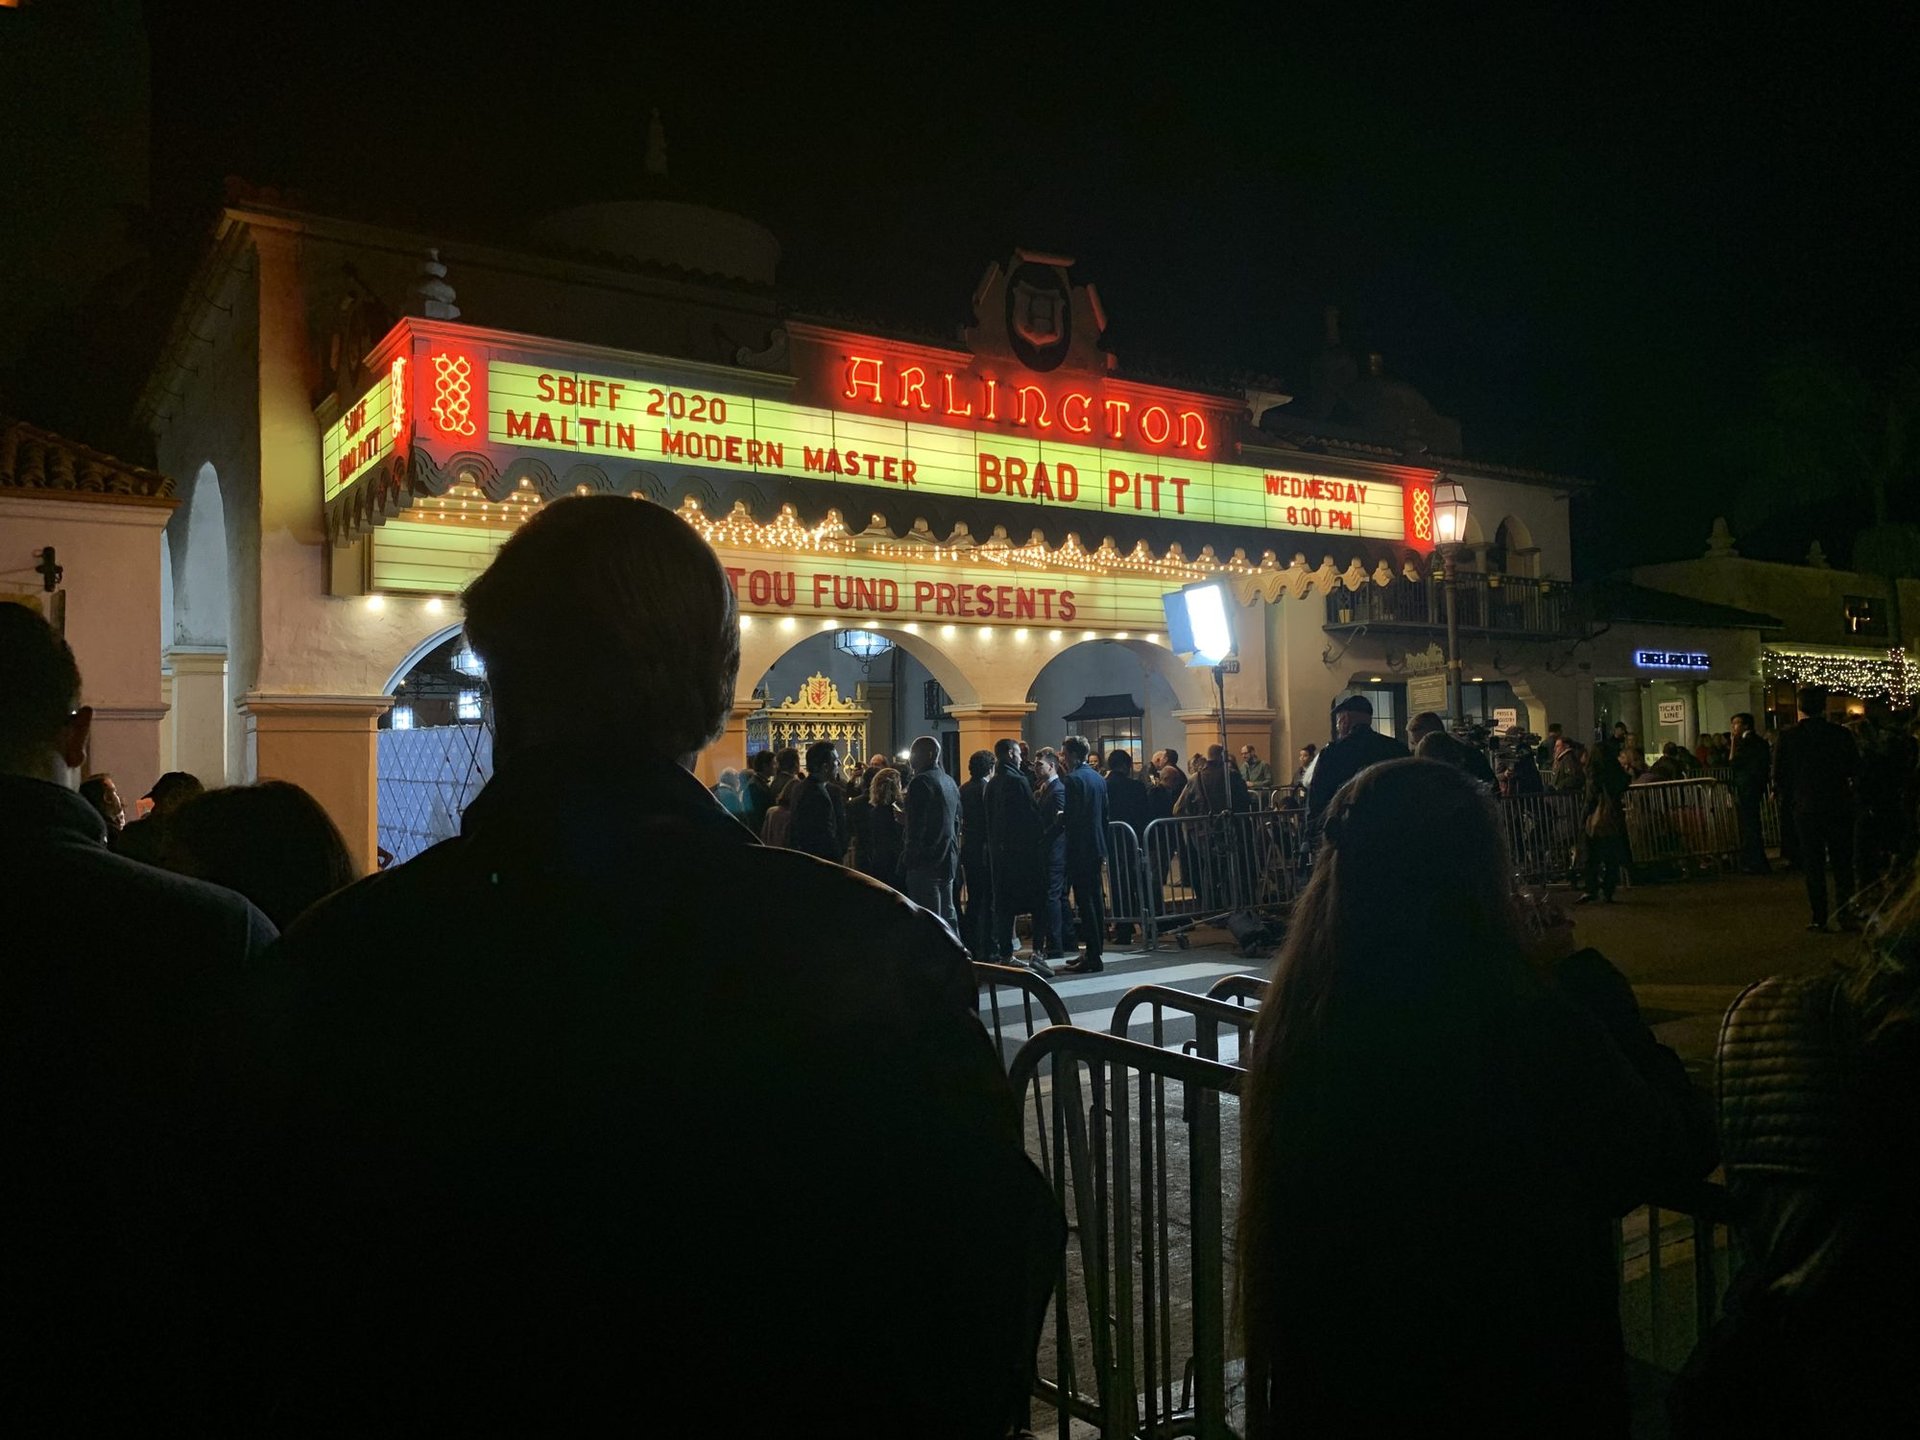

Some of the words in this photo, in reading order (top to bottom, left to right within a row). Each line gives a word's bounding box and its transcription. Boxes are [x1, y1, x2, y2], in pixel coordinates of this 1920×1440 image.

[536, 373, 625, 411] SBIFF
[647, 388, 727, 425] 2020
[846, 356, 1208, 451] ARLINGTON
[506, 409, 636, 452] MALTIN
[660, 428, 784, 469] MODERN
[803, 446, 918, 486] MASTER
[979, 453, 1079, 502] BRAD
[1108, 469, 1190, 515] PITT
[1264, 474, 1367, 504] WEDNESDAY
[1328, 509, 1353, 531] PM
[813, 573, 899, 613] FUND
[915, 580, 1077, 622] PRESENTS
[1659, 704, 1683, 712] TICKET
